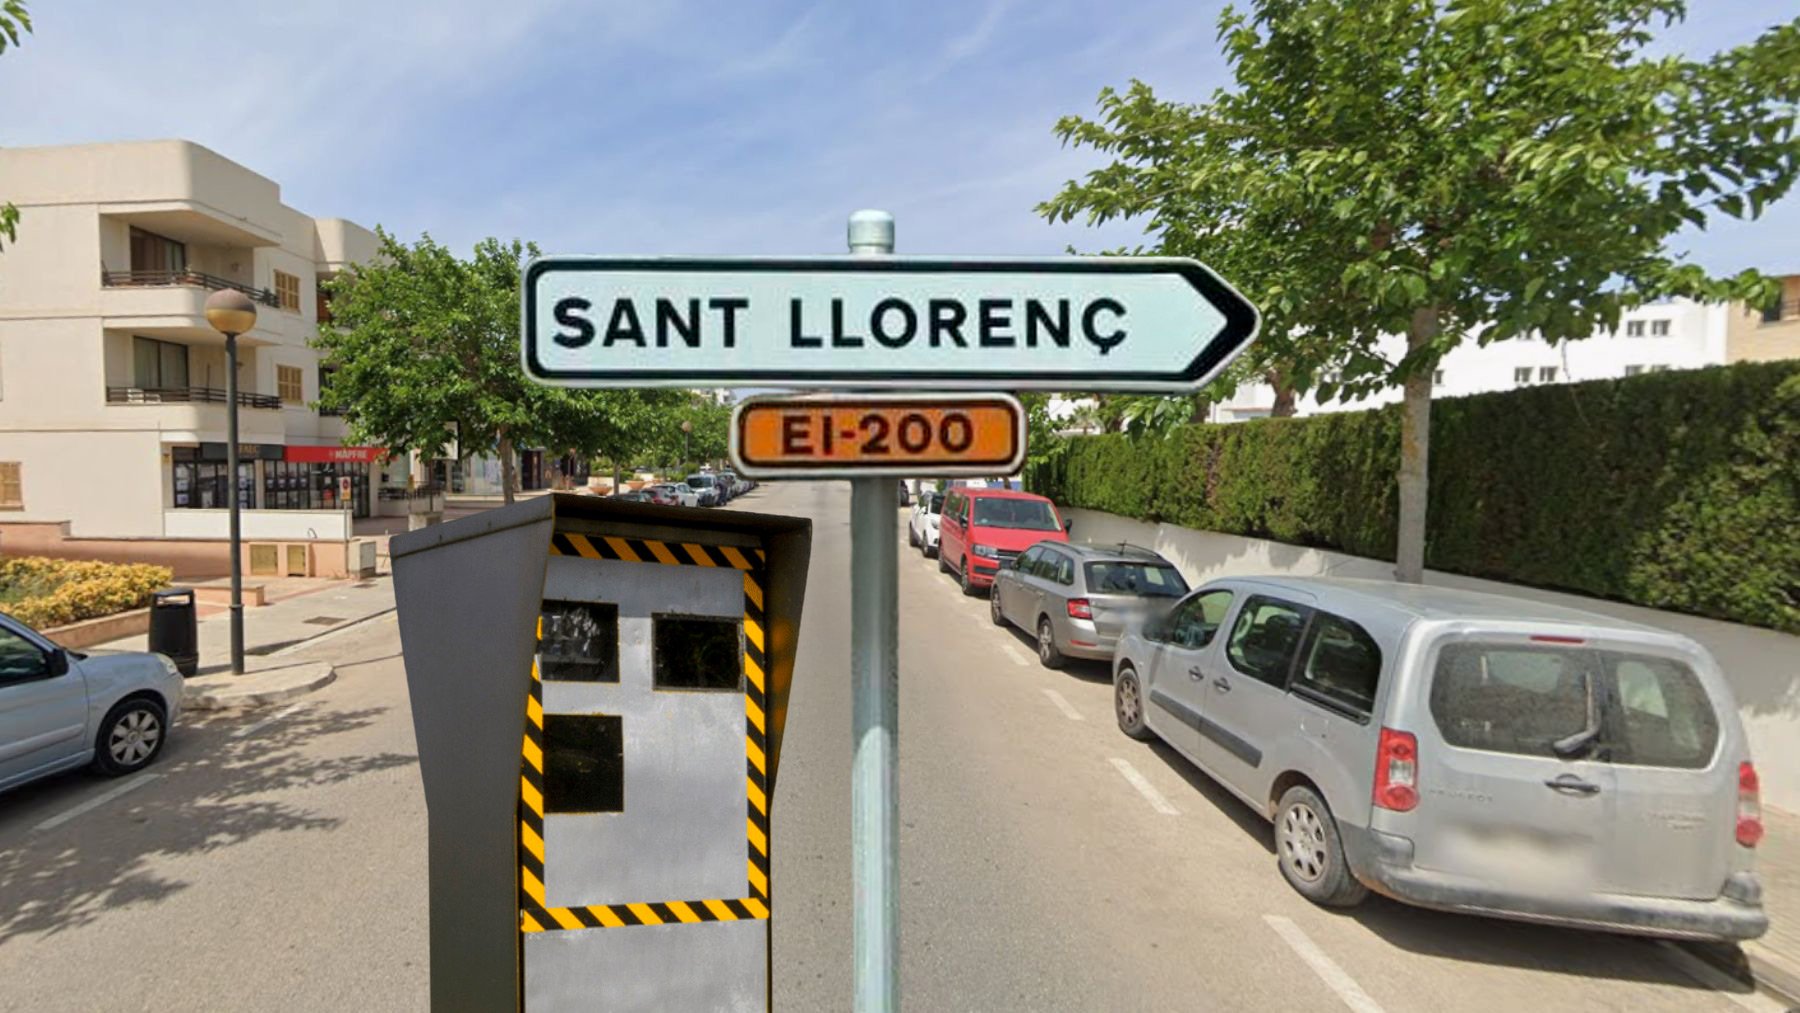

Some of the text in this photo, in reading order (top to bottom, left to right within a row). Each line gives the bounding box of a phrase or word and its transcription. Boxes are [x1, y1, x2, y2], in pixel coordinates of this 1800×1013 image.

[553, 297, 1128, 355] SANT LLORENÇ
[335, 449, 368, 459] MAPFRE
[782, 413, 974, 456] EI-200
